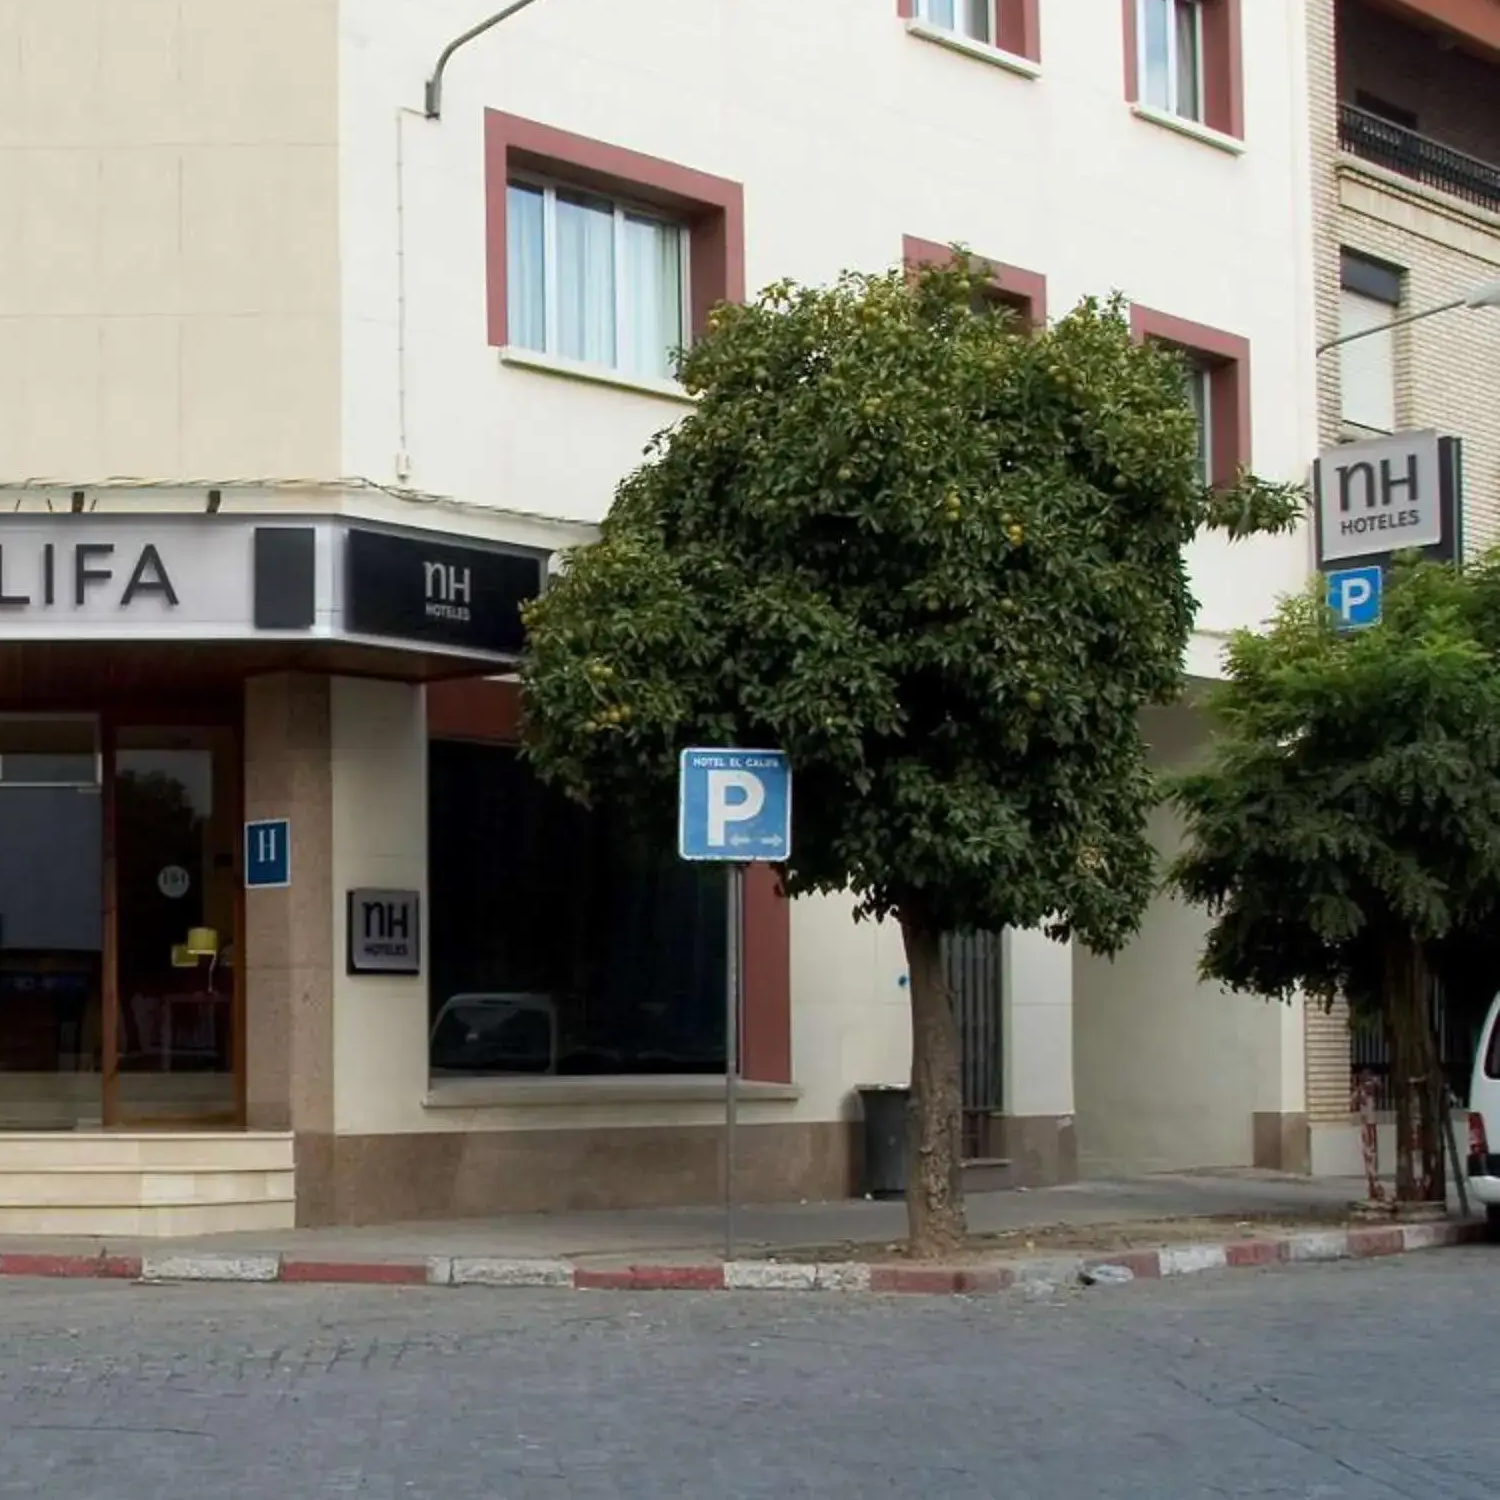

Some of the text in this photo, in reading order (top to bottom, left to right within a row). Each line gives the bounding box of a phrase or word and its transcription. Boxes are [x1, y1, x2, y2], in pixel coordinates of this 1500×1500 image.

[1341, 509, 1420, 536] HOTELES
[1341, 577, 1372, 619] P
[693, 756, 725, 768] HOTEL
[729, 756, 743, 768] EL
[707, 769, 765, 847] P
[257, 828, 276, 863] H
